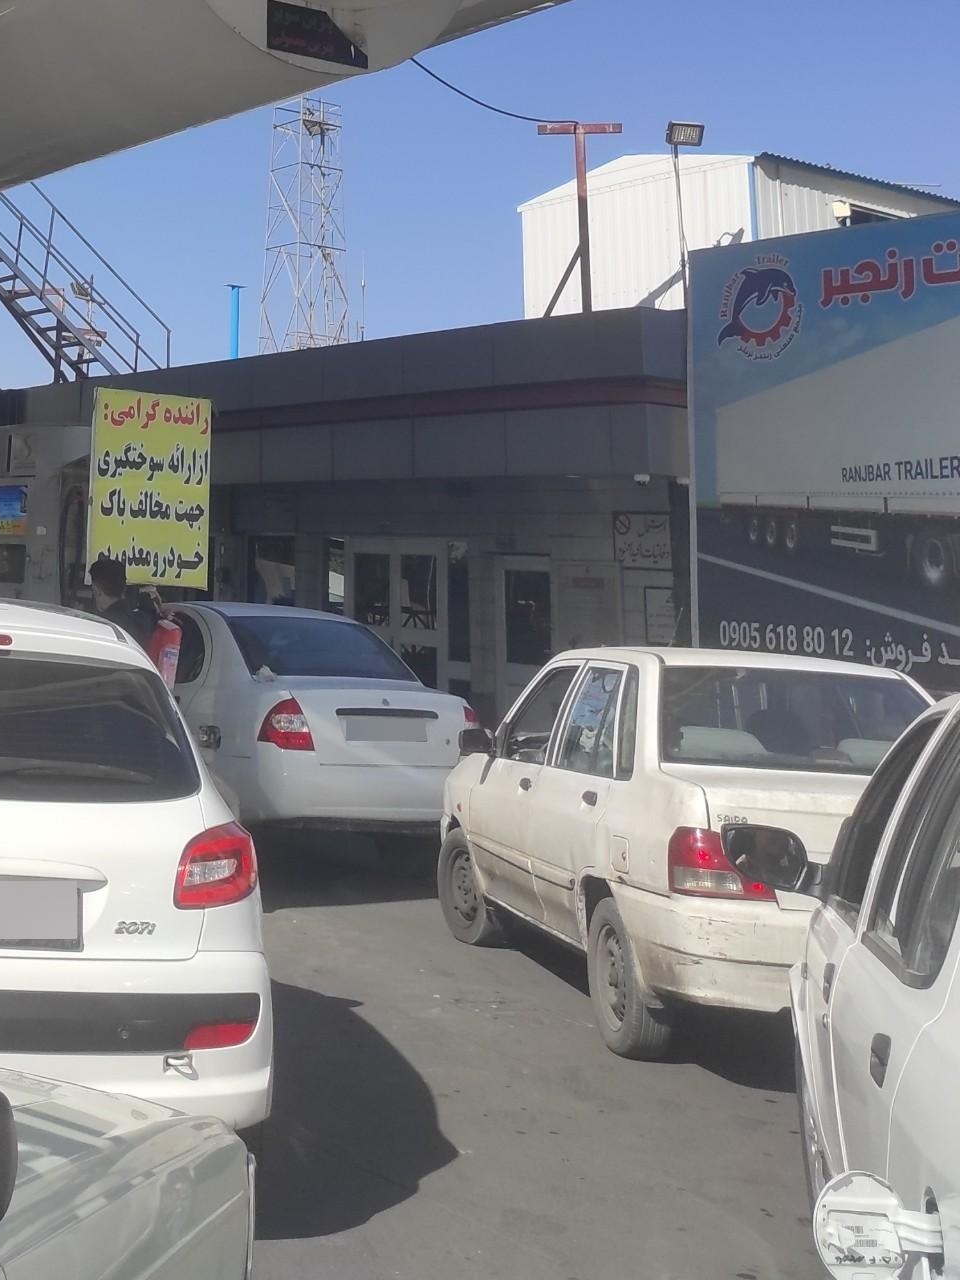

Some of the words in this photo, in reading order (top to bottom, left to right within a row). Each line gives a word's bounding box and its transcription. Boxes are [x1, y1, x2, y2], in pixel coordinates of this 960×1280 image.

[819, 248, 916, 308] رنجبر
[103, 397, 160, 429] گرامی:
[163, 402, 209, 435] راننده
[97, 442, 165, 482] سوختگیری
[168, 443, 196, 485] ارائه
[196, 447, 209, 486] از
[841, 462, 892, 483] RANJBAR
[895, 455, 960, 481] TRAILER
[100, 487, 126, 525] باک
[129, 490, 171, 520] مخالف
[174, 500, 205, 532] جهت
[151, 541, 204, 579] خودرو
[719, 620, 760, 649] 0905
[765, 625, 797, 652] 618
[803, 626, 825, 654] 80
[831, 628, 854, 657] 12
[865, 631, 932, 673] فروش:
